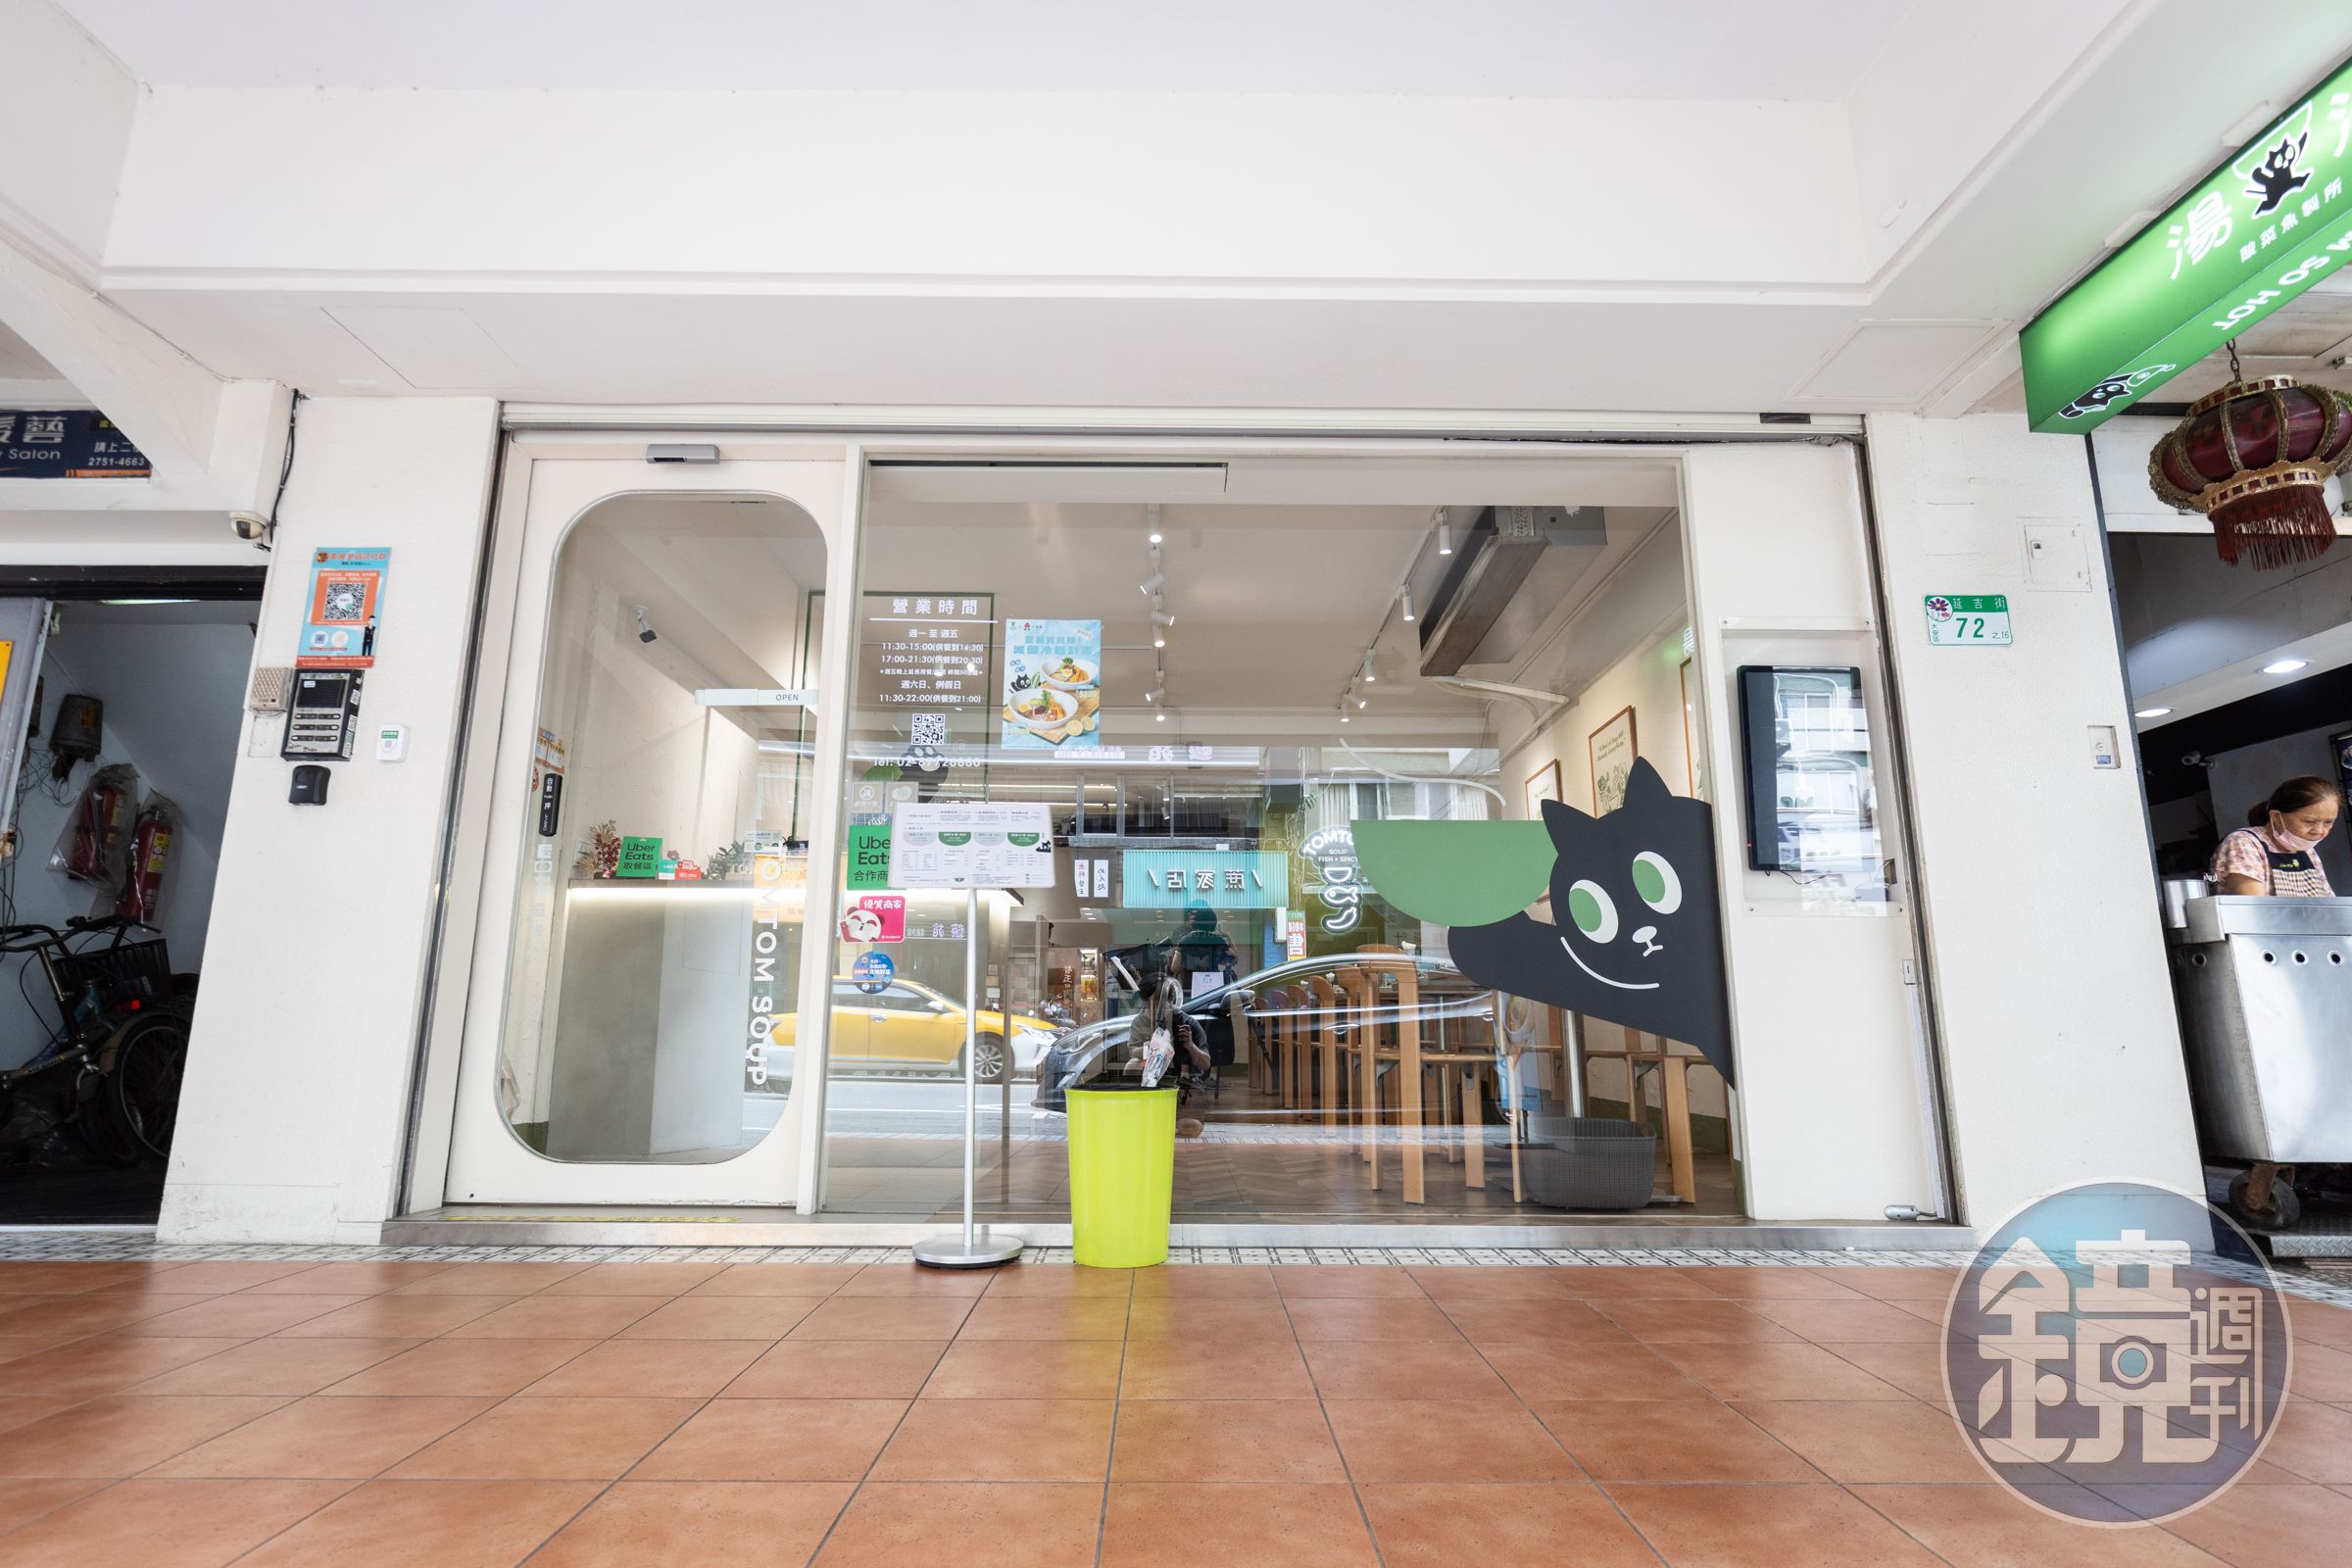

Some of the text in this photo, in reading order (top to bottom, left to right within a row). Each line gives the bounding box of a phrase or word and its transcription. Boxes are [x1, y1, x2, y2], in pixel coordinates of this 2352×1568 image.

[2238, 176, 2343, 264] 酸菜魚製所
[2166, 190, 2232, 281] 湯
[2278, 255, 2330, 286] SO
[2212, 289, 2281, 330] HOT
[93, 441, 139, 453] 請上二
[8, 448, 61, 461] Salon
[87, 457, 145, 466] 2751-4663
[892, 598, 978, 615] 營業時間
[1952, 597, 2005, 610] 延吉街
[1955, 617, 2010, 640] 72 之16
[627, 843, 656, 852] Uber
[858, 835, 891, 850] Ube
[624, 852, 655, 860] Eats
[623, 861, 653, 870] 取餐區
[854, 869, 889, 881] 合作商
[862, 899, 903, 909] 優質商家
[746, 995, 773, 1086] SOUP
